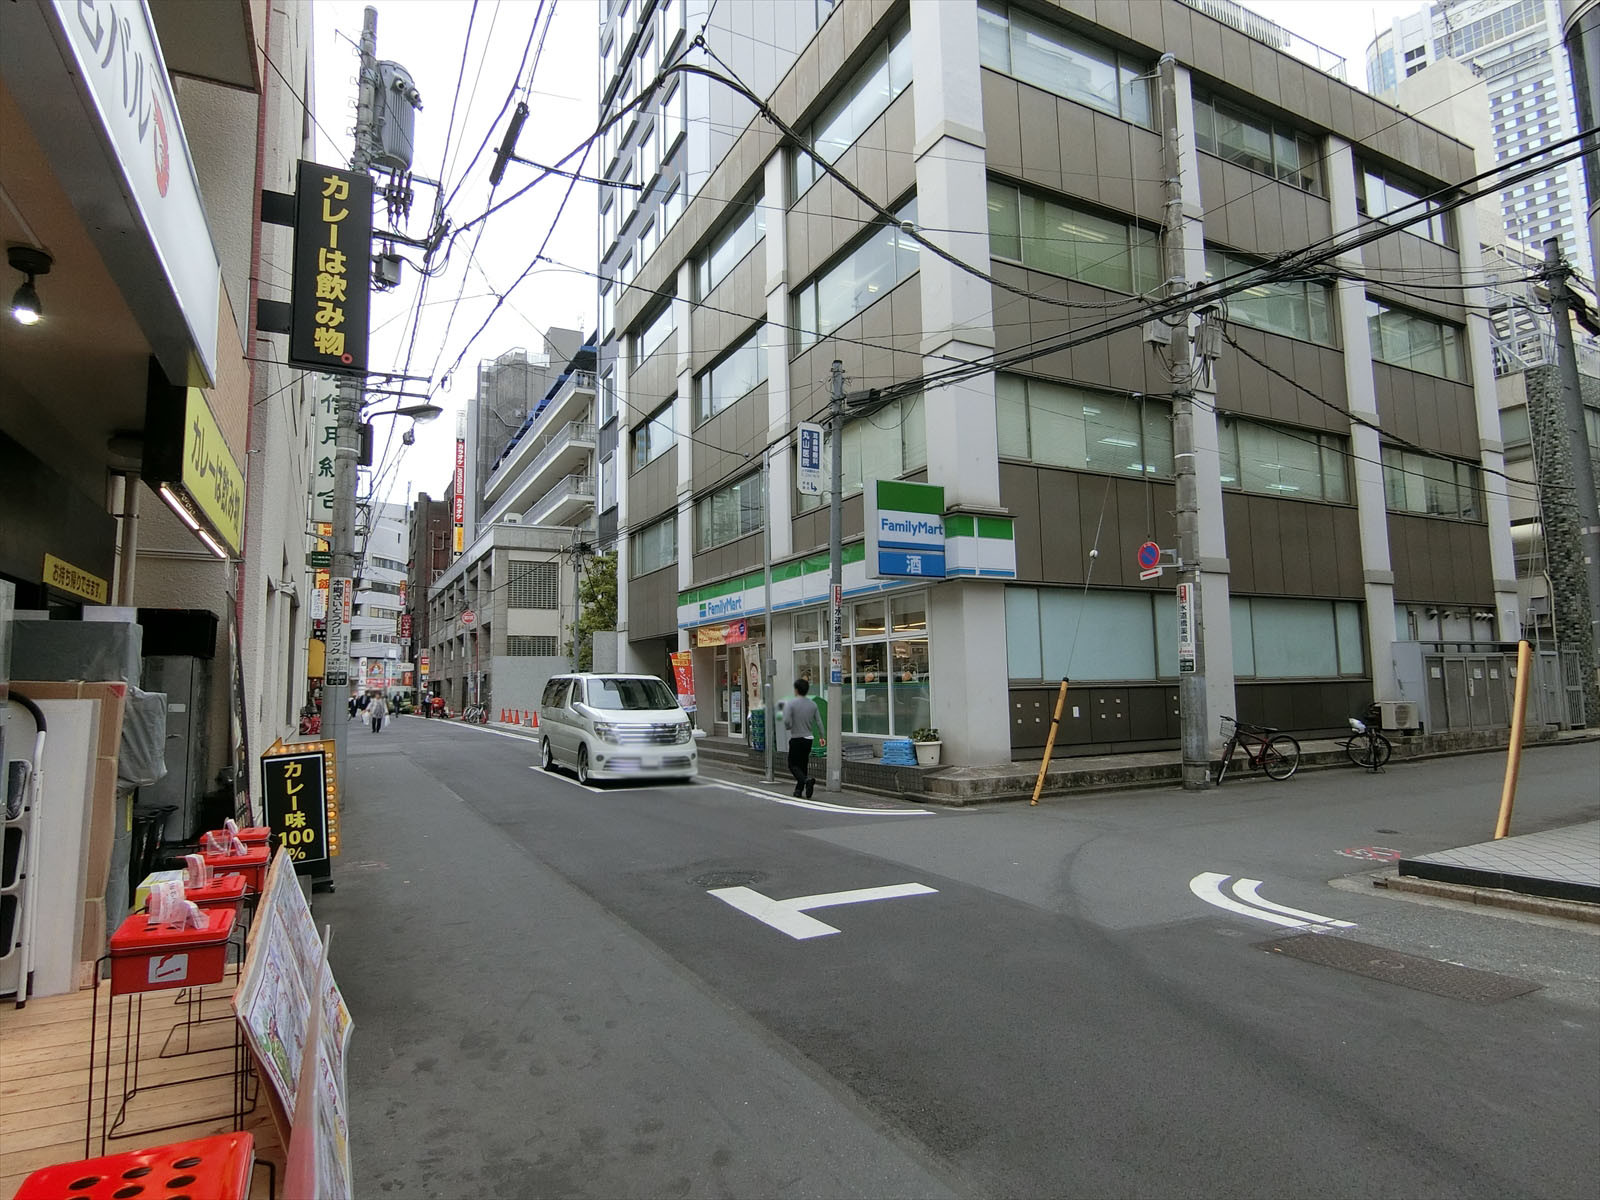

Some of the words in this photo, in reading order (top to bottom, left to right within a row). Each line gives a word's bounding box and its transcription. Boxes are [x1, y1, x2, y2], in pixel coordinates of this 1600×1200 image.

[313, 174, 353, 365] カレーは飲み物。
[881, 517, 944, 537] FamilyMart
[906, 554, 922, 575] 酒
[707, 595, 742, 616] FamilyMart
[283, 761, 307, 828] カレー味
[278, 828, 315, 846] 100
